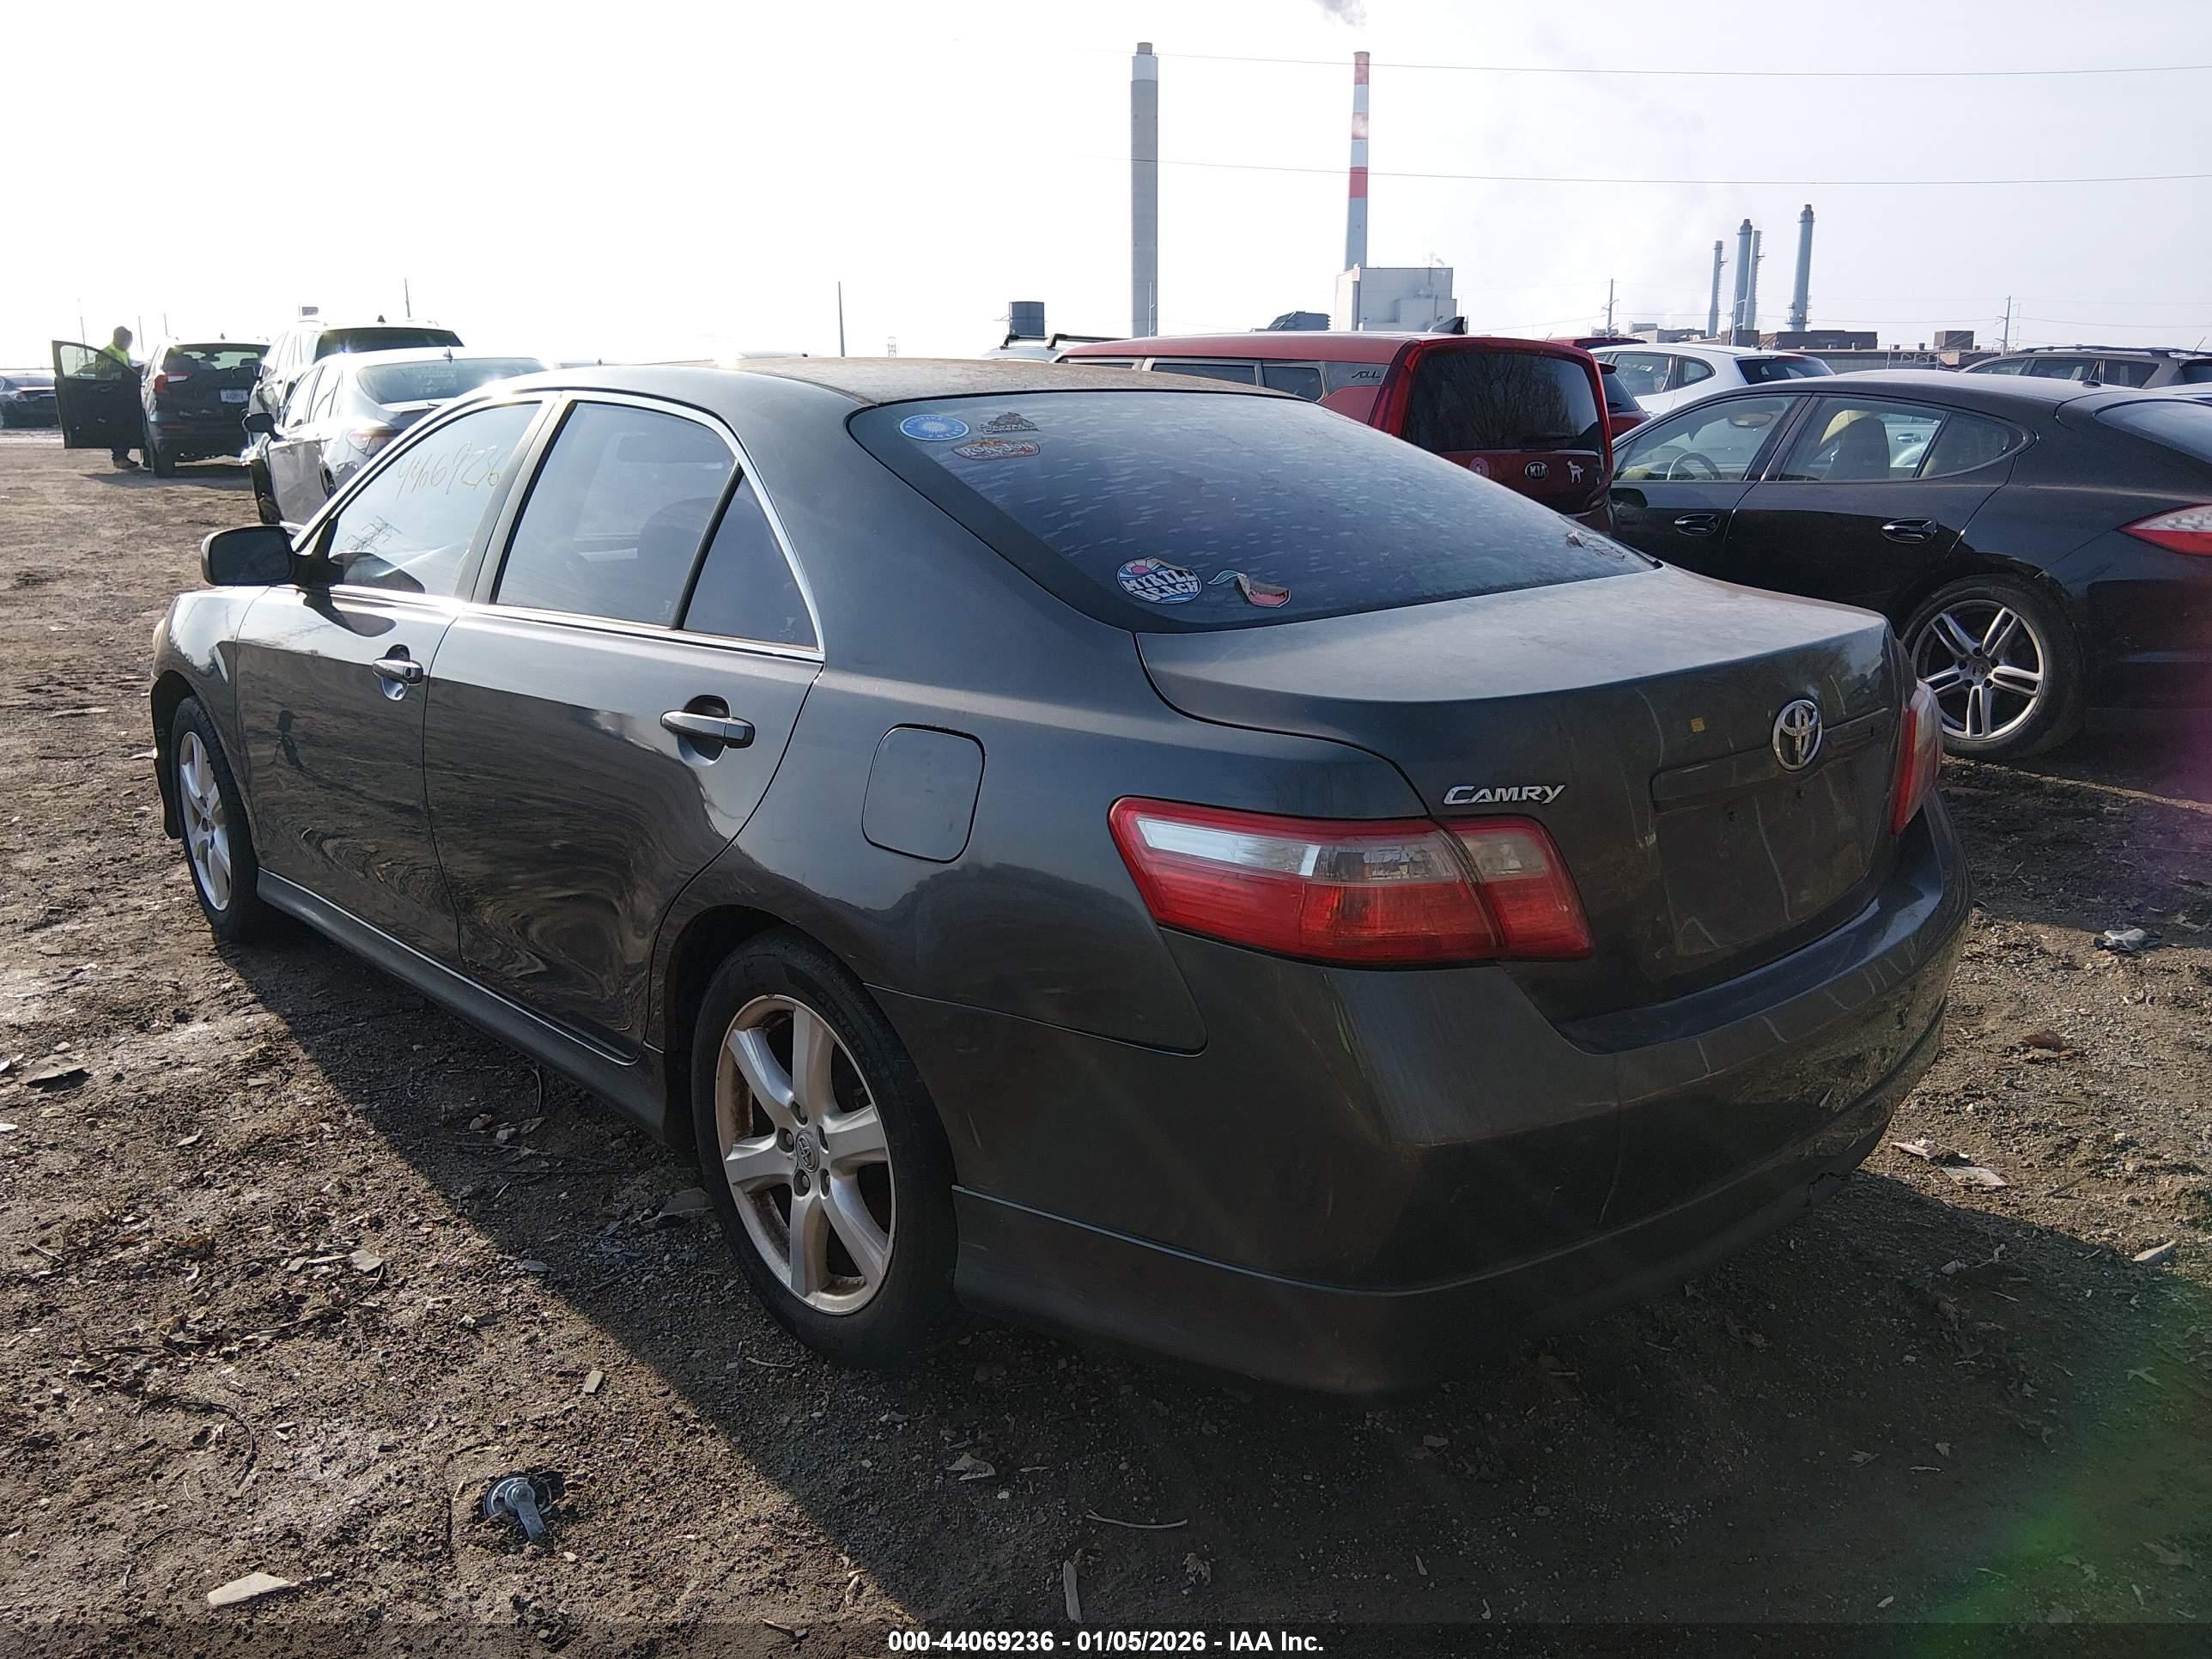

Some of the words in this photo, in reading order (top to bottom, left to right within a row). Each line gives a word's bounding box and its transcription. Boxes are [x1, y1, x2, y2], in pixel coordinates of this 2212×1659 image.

[1528, 465, 1548, 477] KIA
[1121, 568, 1198, 592] MYRTLE
[1133, 580, 1199, 602] BEACH
[1443, 784, 1566, 805] CAMRY
